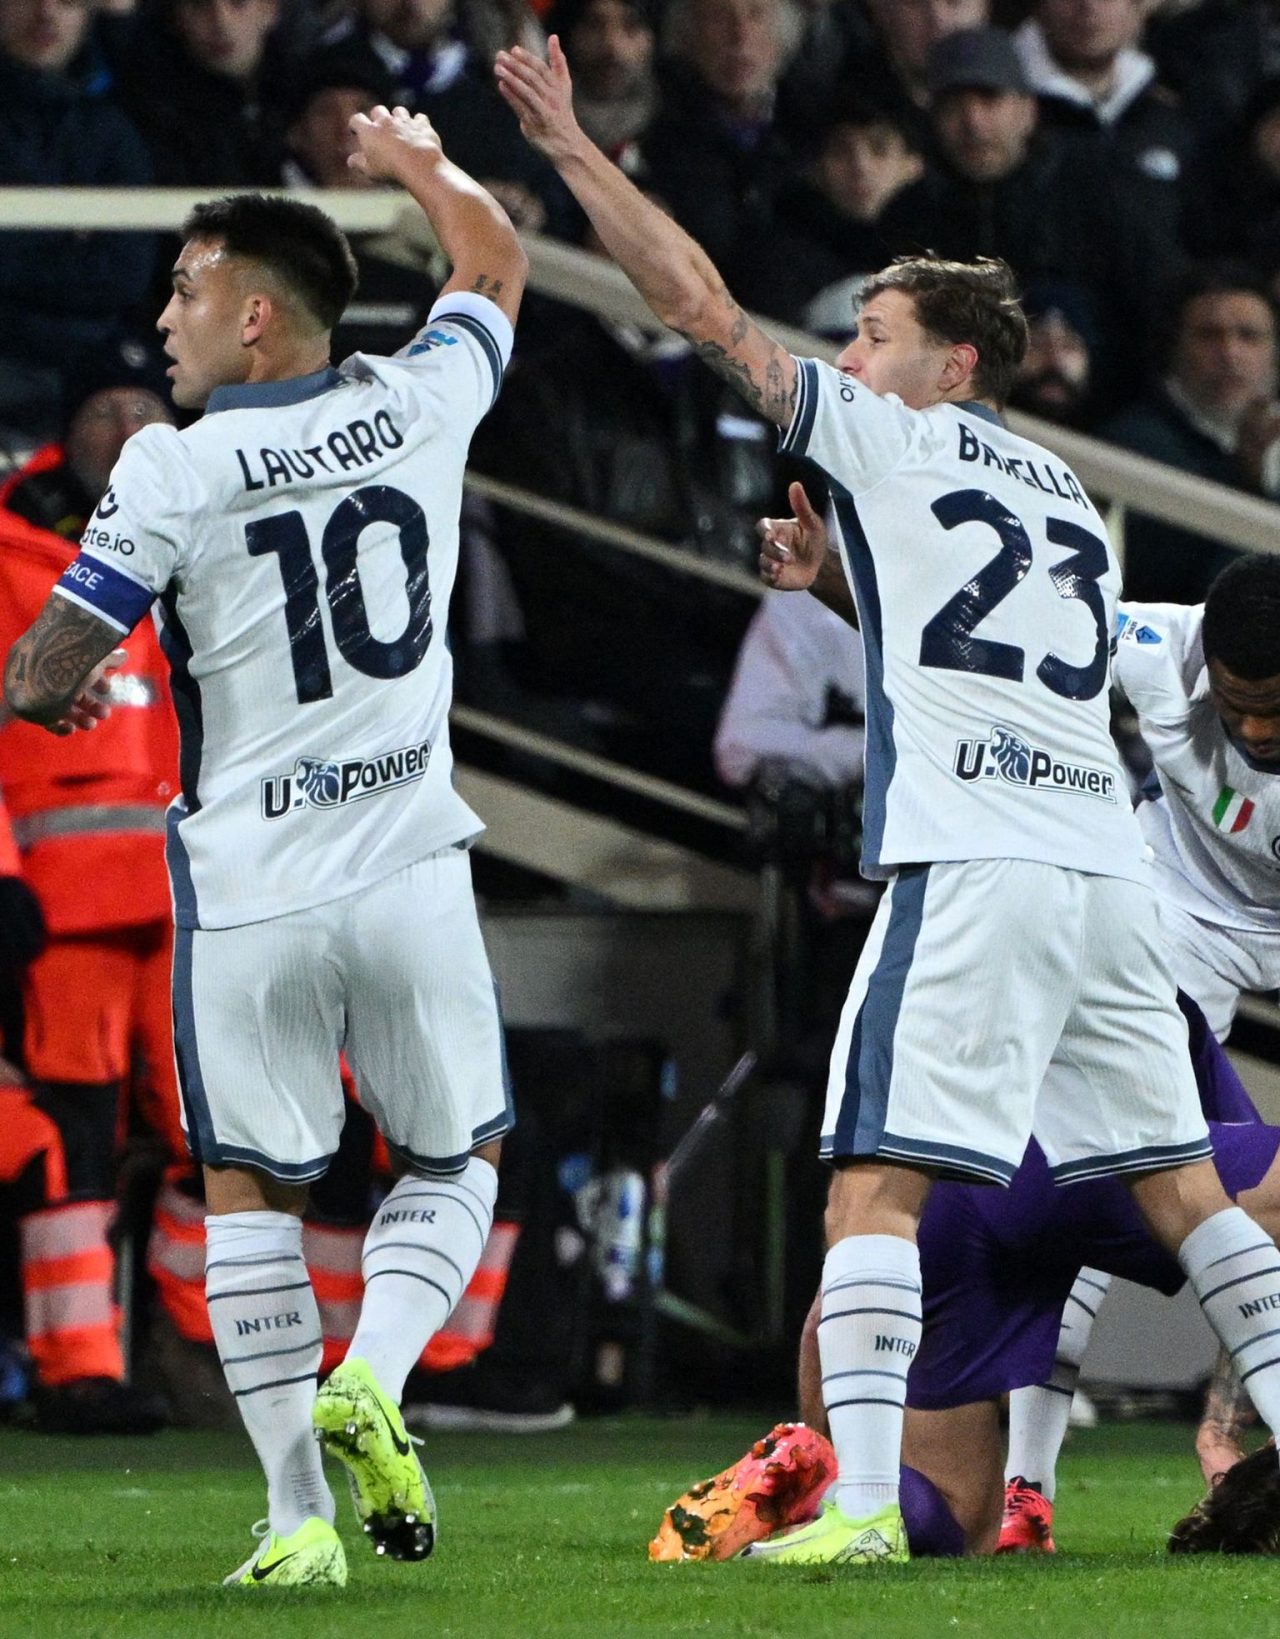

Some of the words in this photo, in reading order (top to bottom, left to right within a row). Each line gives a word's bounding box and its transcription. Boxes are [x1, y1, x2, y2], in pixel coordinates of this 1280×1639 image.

[236, 409, 404, 491] LAUTARO
[244, 484, 433, 704] 10
[919, 488, 1110, 701] 23
[380, 1209, 437, 1226] INTER
[235, 1311, 302, 1336] INTER
[875, 1335, 916, 1359] INTER
